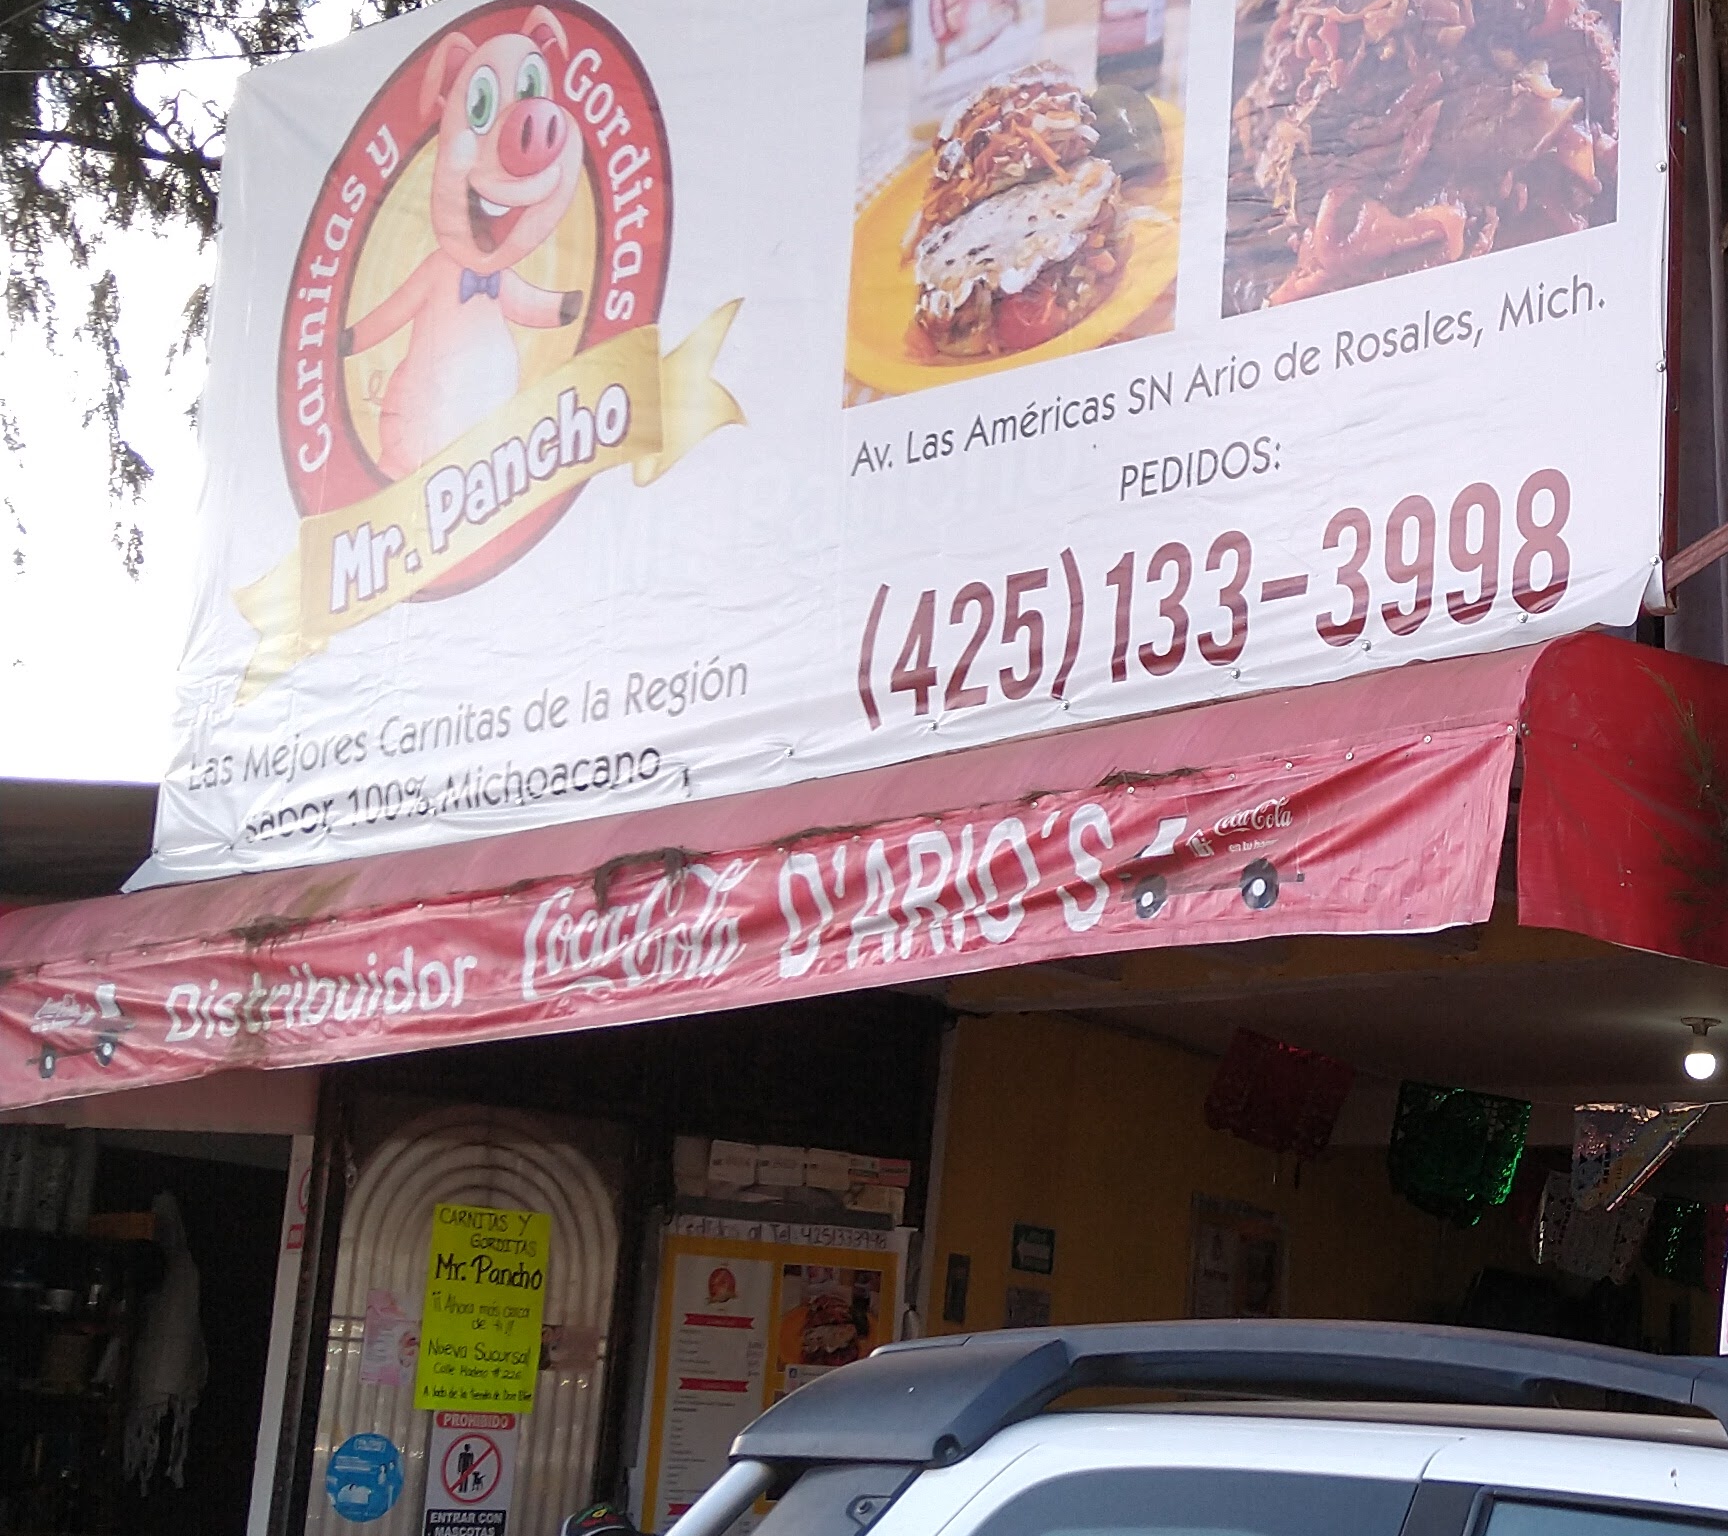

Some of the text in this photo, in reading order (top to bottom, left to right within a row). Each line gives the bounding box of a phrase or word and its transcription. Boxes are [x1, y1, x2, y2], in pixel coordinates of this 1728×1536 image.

[297, 48, 653, 473] Carnitas y Gorditas
[851, 274, 1606, 477] Av. Las Américas SN Ario de Rosales, Mich.
[329, 381, 631, 615] Mr. Pancho
[1119, 436, 1281, 501] PEDIDOS:
[858, 468, 1572, 731] (425)133-3998
[188, 655, 749, 792] Las Mejores Carnitas de la Región
[441, 746, 661, 812] Michoacano
[164, 946, 478, 1043] Distribuidor
[778, 803, 1115, 978] D'ARIO'S
[439, 1207, 534, 1236] CARNITAS Y
[470, 1233, 538, 1258] GORDITAS
[435, 1252, 544, 1291] Mr. Pancho
[428, 1338, 532, 1367] Nueva Sucursal
[443, 1414, 510, 1430] PROHIBIDO
[430, 1511, 503, 1525] ENTRAR CON
